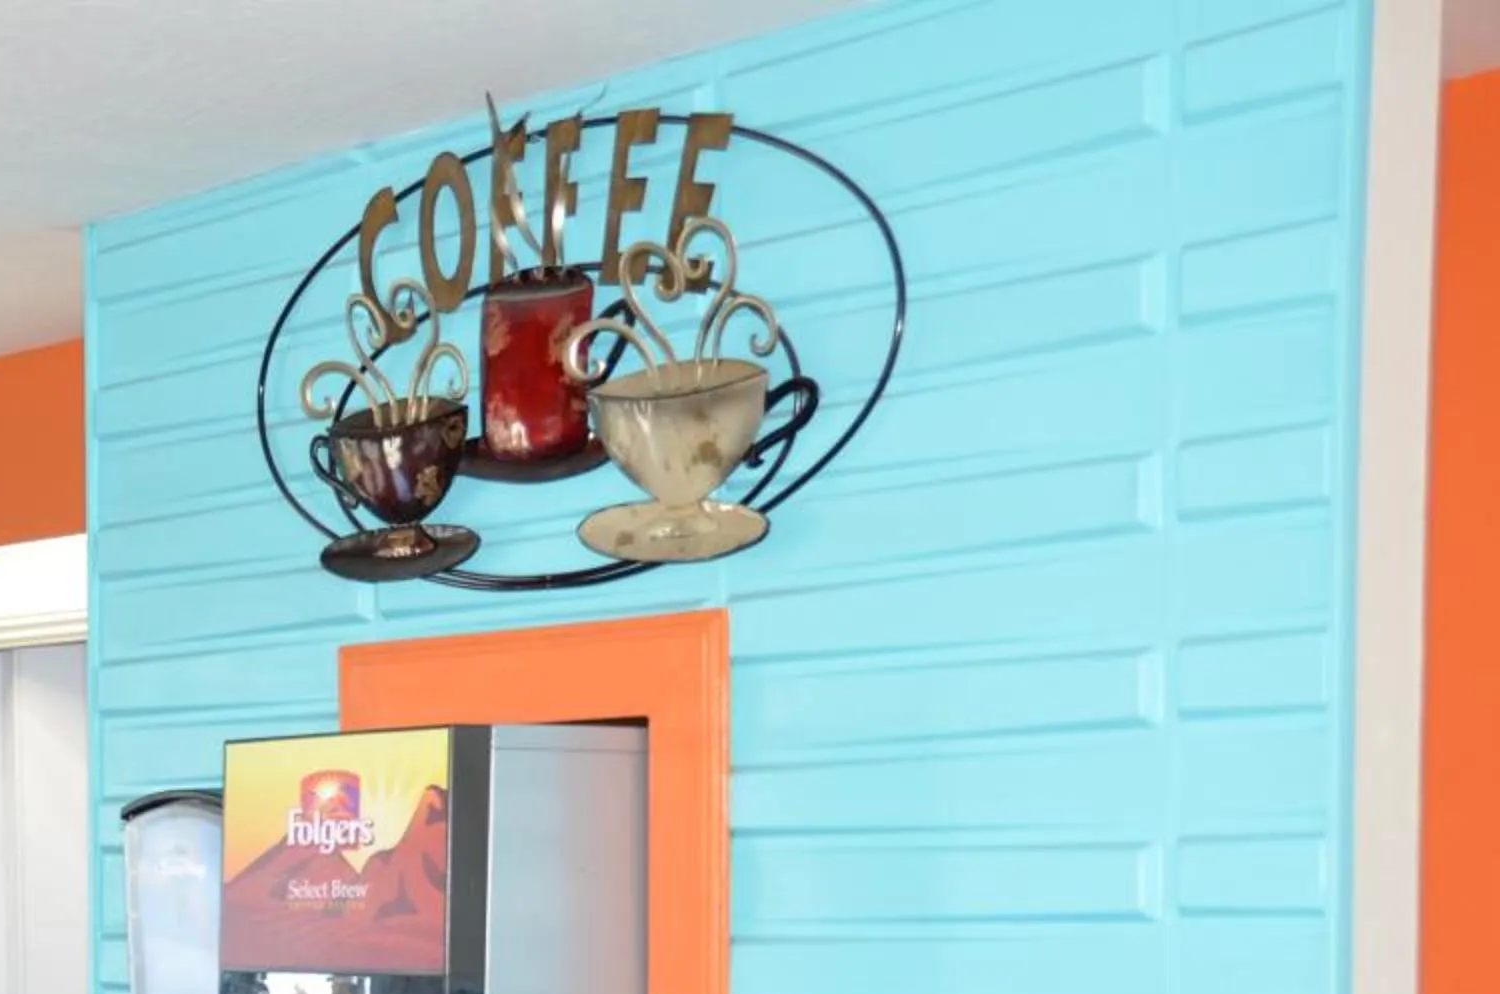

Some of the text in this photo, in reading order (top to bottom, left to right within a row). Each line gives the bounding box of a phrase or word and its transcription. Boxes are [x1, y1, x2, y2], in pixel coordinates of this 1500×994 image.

[359, 107, 734, 344] COFFEE
[286, 807, 376, 854] Folgers
[286, 878, 369, 899] Select Brew
